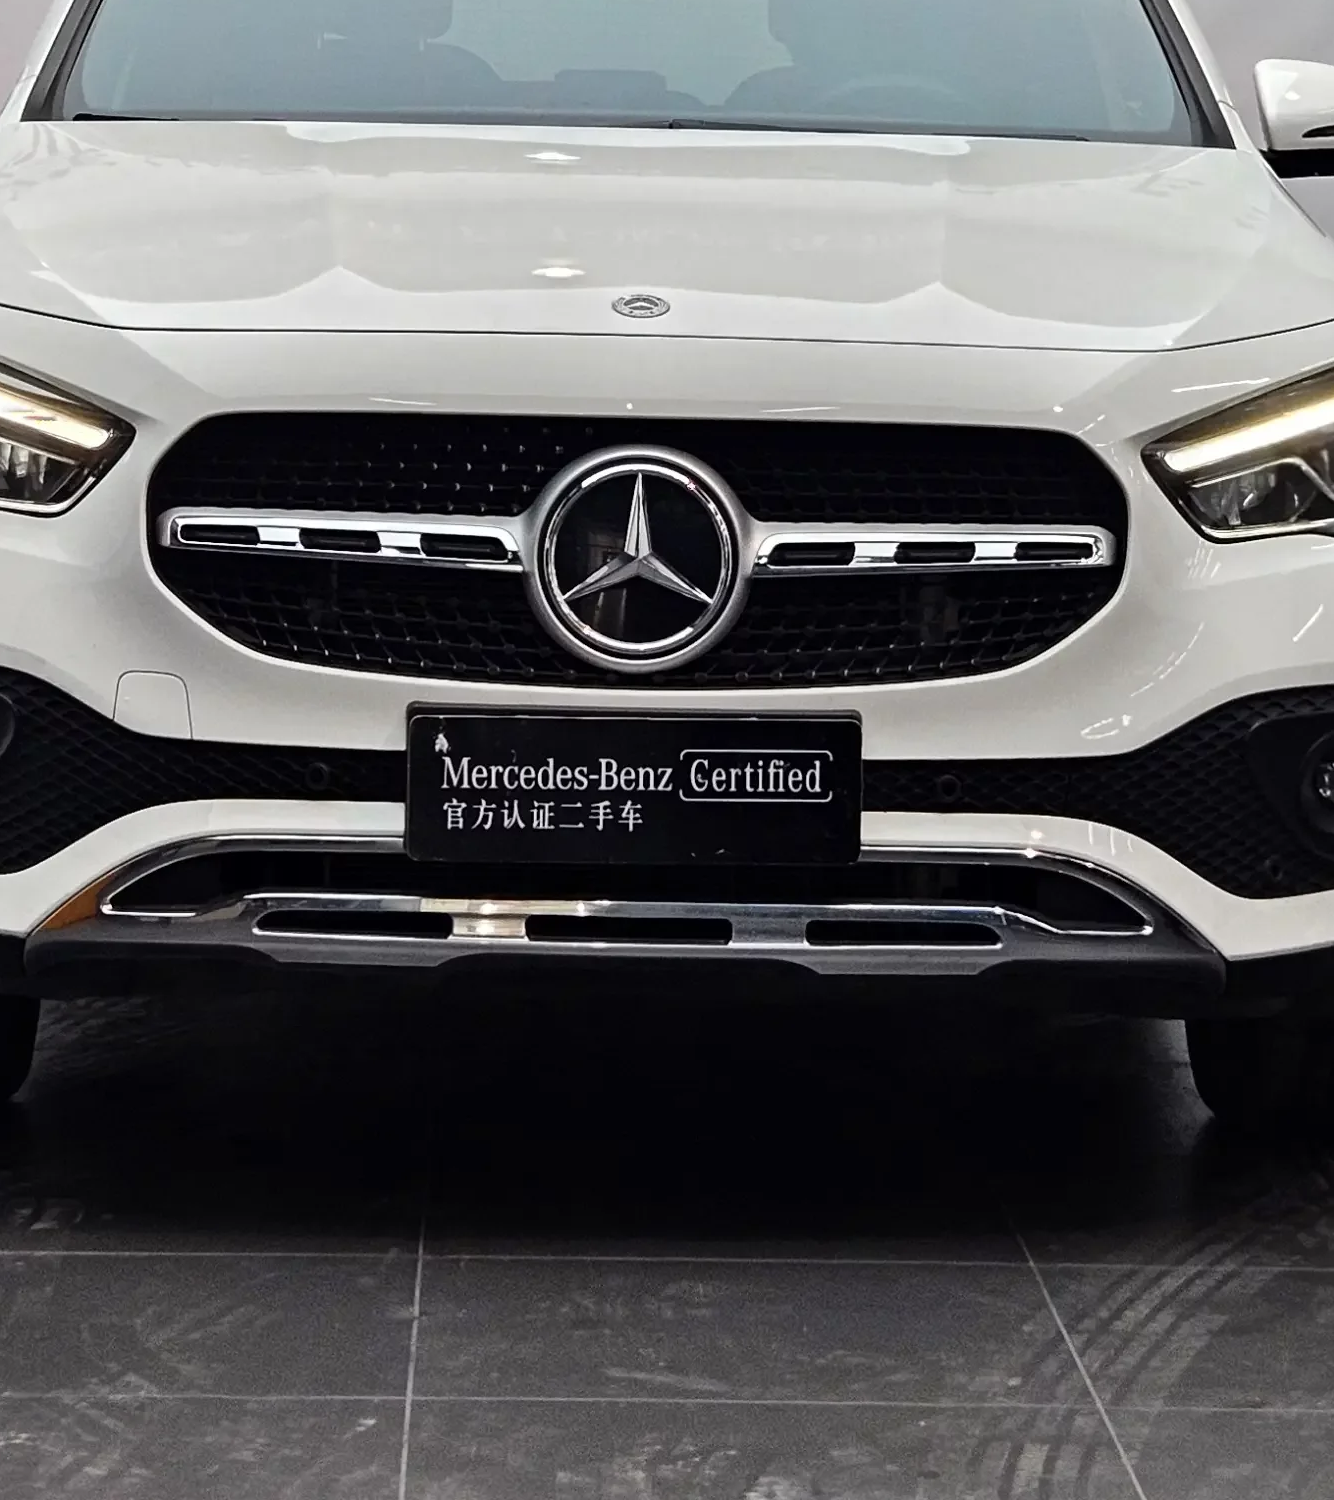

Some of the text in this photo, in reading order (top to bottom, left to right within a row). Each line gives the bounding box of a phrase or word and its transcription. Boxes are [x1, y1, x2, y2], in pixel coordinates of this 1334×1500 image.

[440, 755, 823, 794] Mercedes-Benz Certified
[442, 798, 644, 833] 官方认证二手车
